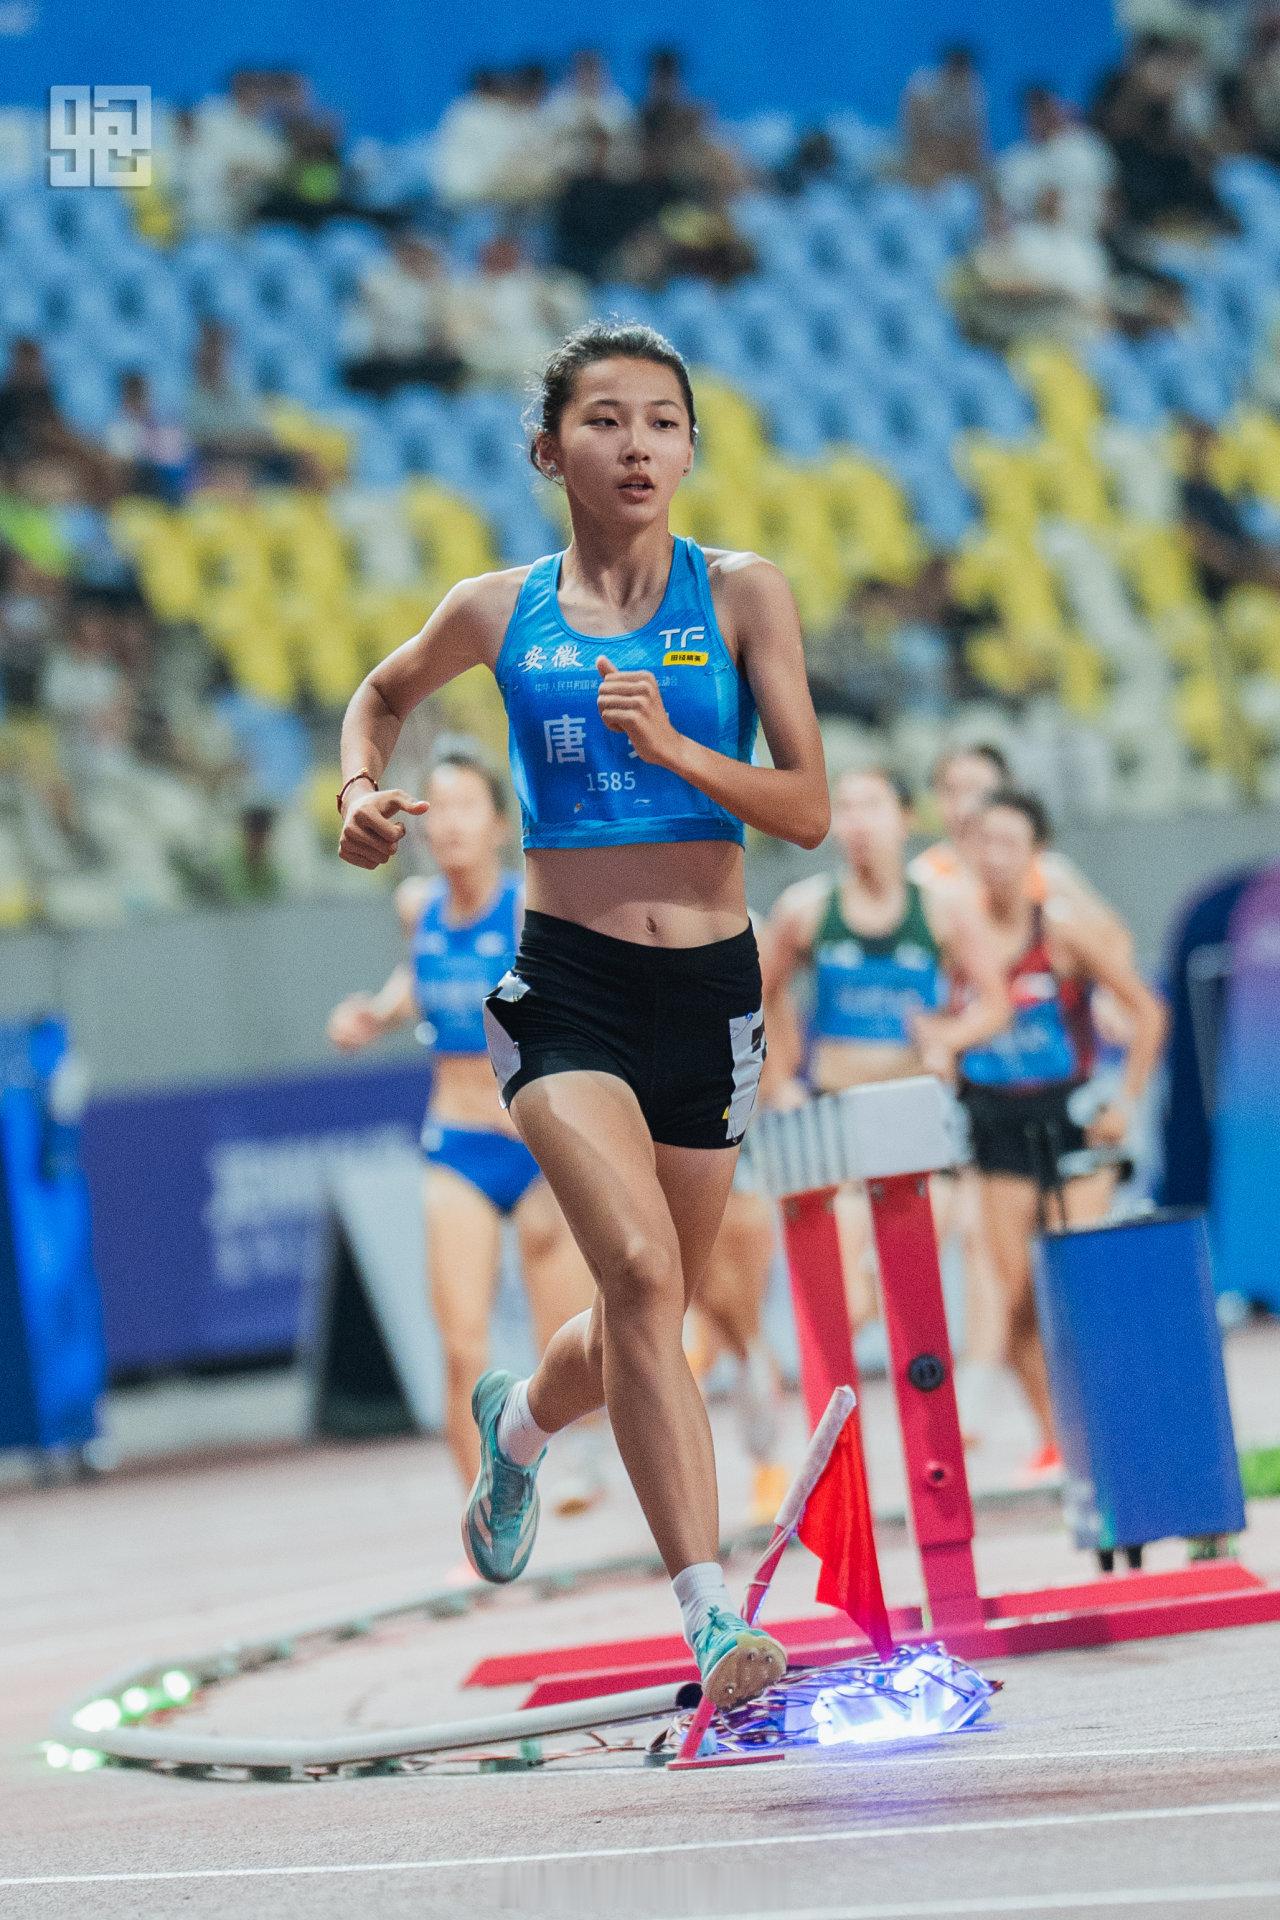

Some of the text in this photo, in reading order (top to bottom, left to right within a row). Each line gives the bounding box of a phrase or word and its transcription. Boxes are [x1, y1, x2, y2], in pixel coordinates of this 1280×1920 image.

[659, 626, 705, 649] TF
[517, 644, 584, 672] 安徽
[543, 714, 587, 763] 唐
[585, 770, 636, 791] 1585
